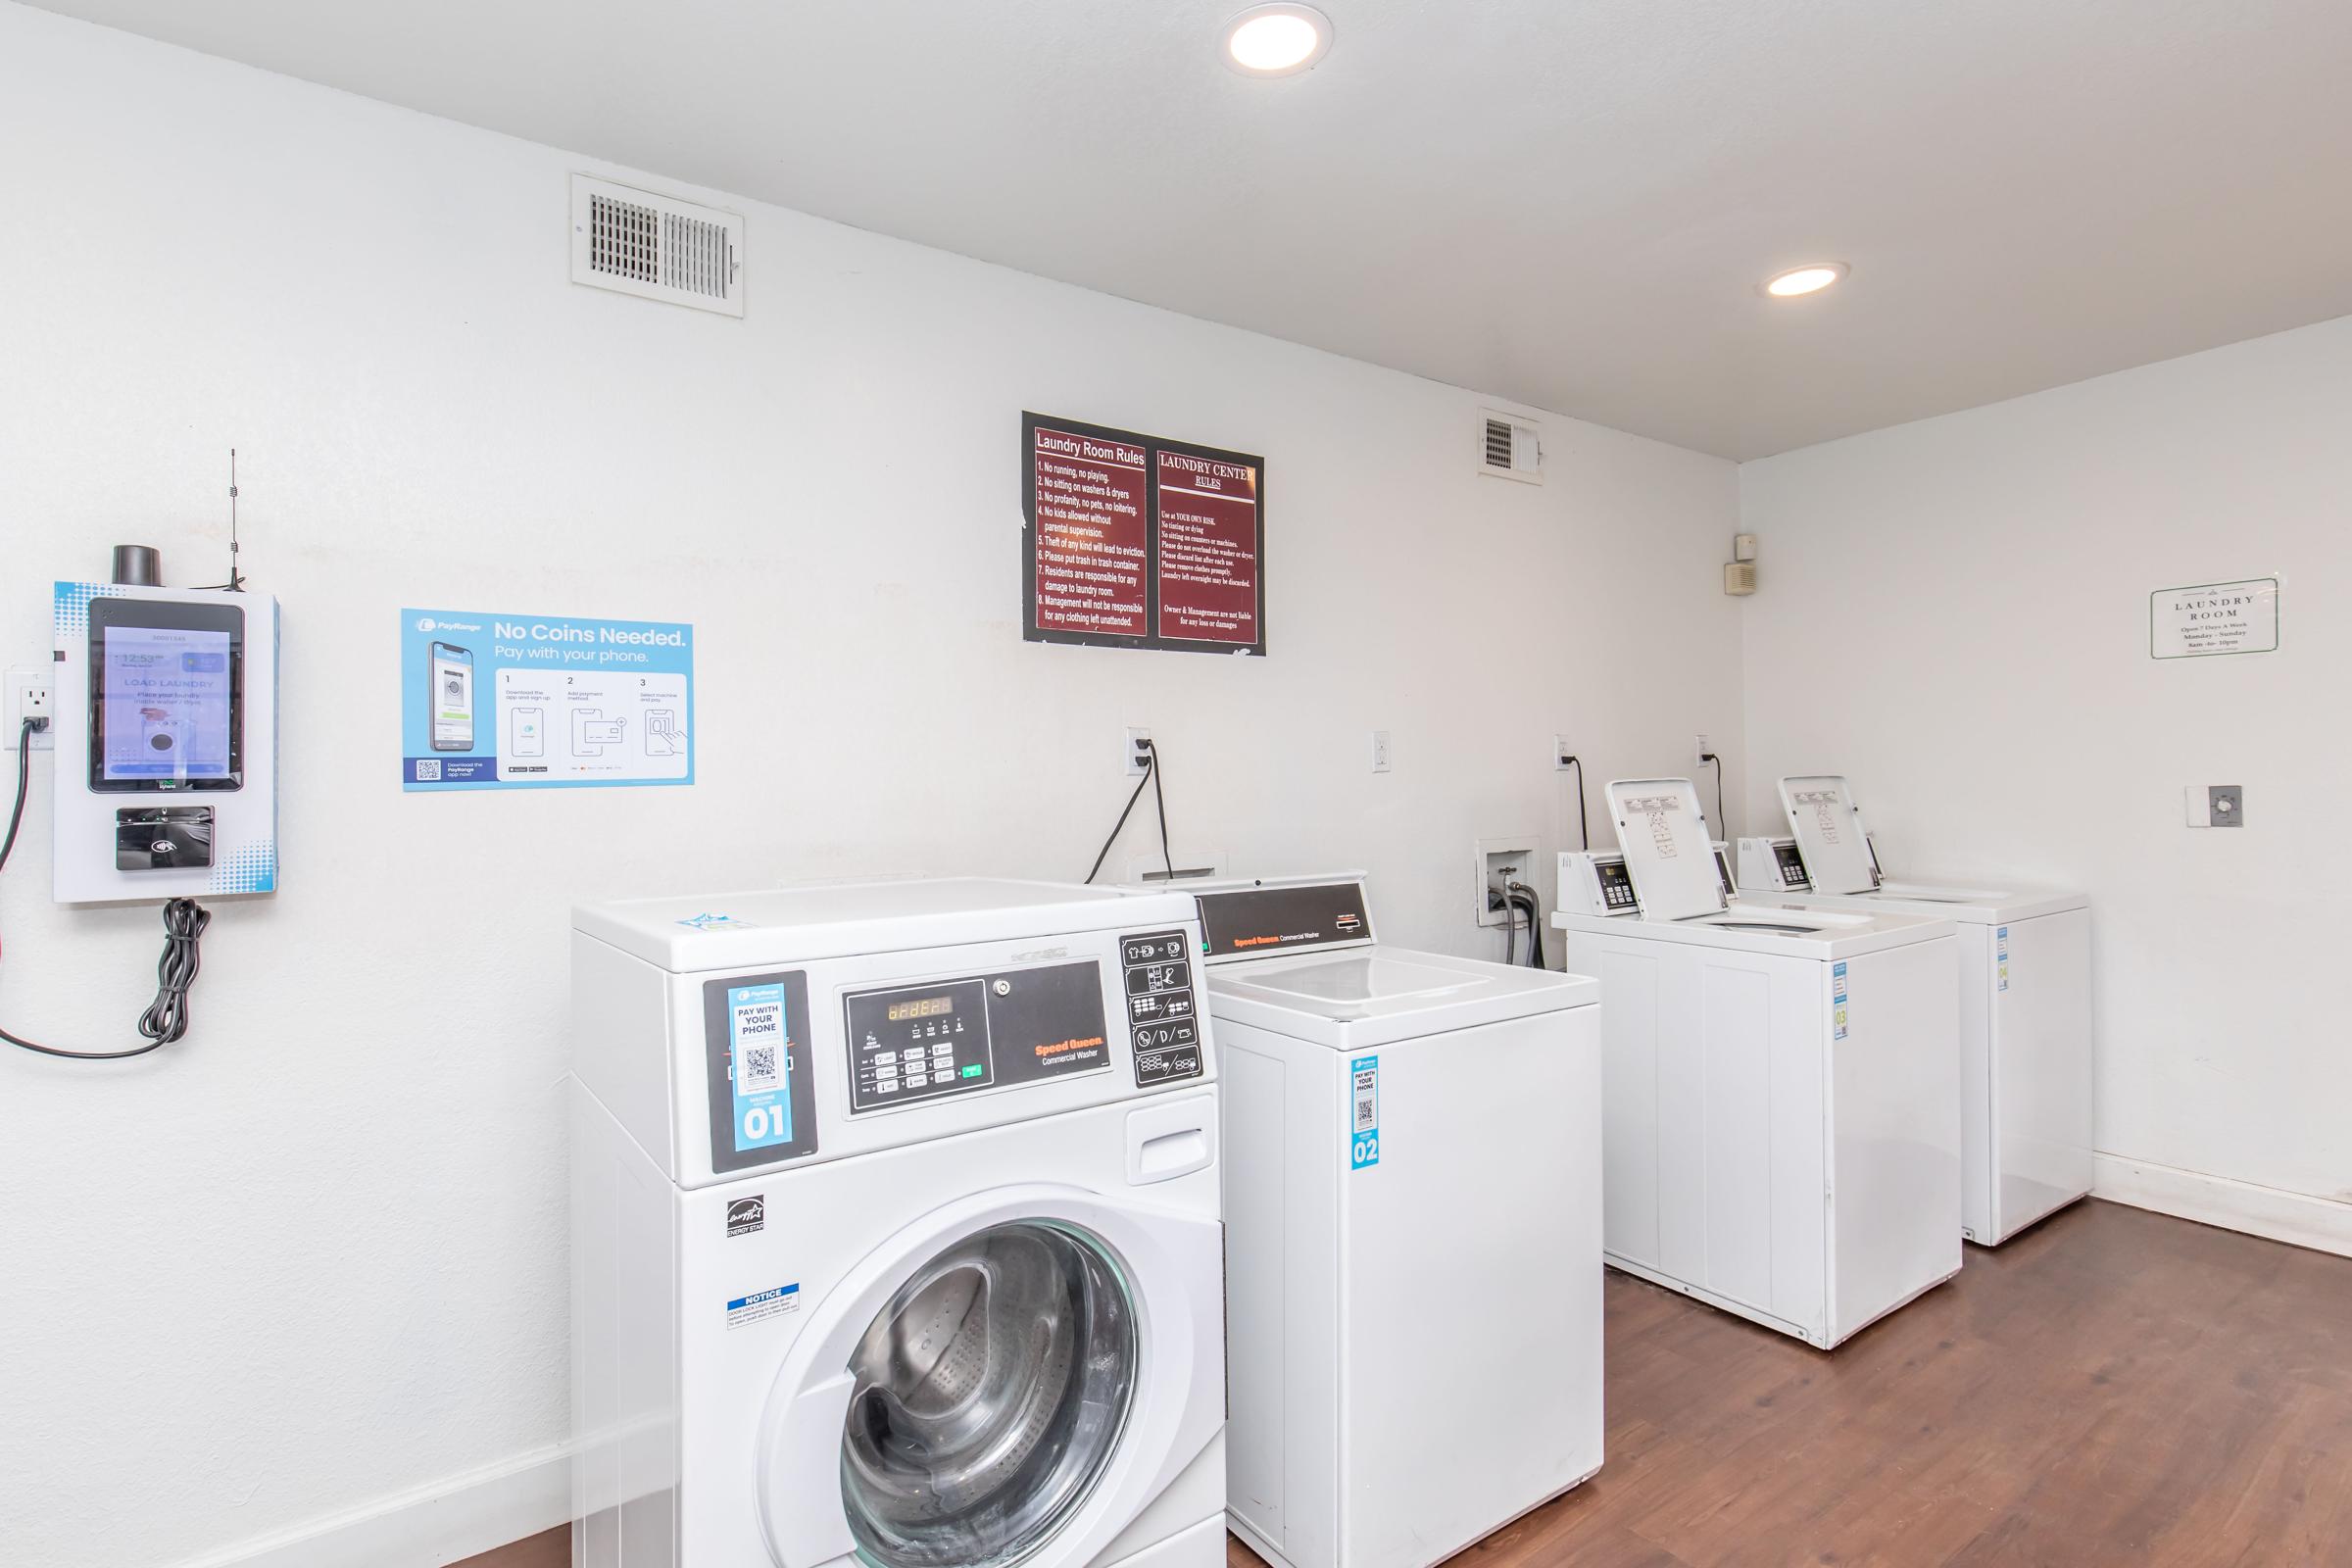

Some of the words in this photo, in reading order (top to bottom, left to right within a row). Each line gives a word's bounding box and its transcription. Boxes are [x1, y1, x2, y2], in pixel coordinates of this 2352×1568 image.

[1037, 433, 1080, 457] Laundry
[1084, 441, 1113, 460] Room
[1117, 448, 1144, 465] Rules
[1038, 461, 1043, 470] 1.
[1045, 463, 1053, 472] No
[1054, 466, 1077, 478] running,
[1088, 470, 1108, 484] playing.
[1160, 454, 1210, 474] LAUNDRY
[1213, 464, 1253, 481] CENTER
[1038, 475, 1043, 485] 2.
[1045, 476, 1053, 486] No
[1054, 479, 1072, 492] sitting
[1082, 484, 1104, 495] washers
[1106, 487, 1109, 496] &
[1111, 488, 1129, 500] dryers
[1196, 476, 1220, 488] RULES
[1039, 490, 1043, 500] 3.
[1045, 492, 1053, 502] No
[1054, 494, 1080, 508] profanity,
[1091, 500, 1103, 511] pets,
[1113, 502, 1137, 516] loitering.
[1039, 506, 1043, 514] 4.
[1045, 506, 1053, 515] No
[1054, 508, 1066, 517] kids
[1068, 510, 1089, 521] allowed
[1091, 514, 1111, 524] without
[1045, 523, 1068, 533] parental
[1069, 526, 1103, 537] supervision.
[1191, 525, 1203, 534] dying
[1039, 535, 1043, 545] 5.
[1045, 536, 1059, 547] Theft
[1061, 538, 1066, 547] of
[1068, 541, 1078, 551] any
[1080, 540, 1092, 551] kind
[1094, 543, 1102, 552] will
[1103, 544, 1114, 554] lead
[1116, 546, 1121, 555] to
[1123, 547, 1145, 557] eviction.
[1039, 551, 1043, 560] 6.
[1045, 551, 1063, 562] Please
[1065, 555, 1074, 564] put
[1076, 555, 1090, 564] trash
[1092, 557, 1097, 565] in
[1098, 558, 1111, 566] trash
[1113, 561, 1139, 570] container.
[1039, 564, 1043, 574] 7.
[1045, 565, 1073, 577] Residents
[1085, 572, 1116, 582] responsible
[1127, 576, 1136, 586] any
[1045, 580, 1067, 594] damage
[1076, 584, 1097, 596] laundry
[1039, 594, 1043, 604] 8.
[1045, 595, 1081, 608] Management
[1082, 599, 1092, 608] will
[1103, 601, 1110, 610] be
[1111, 604, 1143, 613] responsible
[1164, 605, 1181, 613] Owner
[1188, 607, 1219, 616] Management
[2175, 595, 2253, 610] LAUNDRY
[1054, 613, 1064, 622] any
[1066, 612, 1089, 624] clothing
[1101, 616, 1132, 626] unattended.
[2189, 609, 2236, 620] ROOM
[438, 621, 480, 632] PayRange
[1216, 620, 1237, 629] damages
[494, 622, 525, 640] No
[531, 623, 594, 643] Coins
[600, 627, 685, 647] Needed.
[495, 645, 519, 660] Pay
[526, 646, 559, 659] with
[563, 650, 594, 662] your
[600, 649, 648, 664] phone.
[1234, 937, 1257, 947] Speed
[738, 1006, 755, 1017] PAY
[757, 1004, 778, 1014] WITH
[1836, 1010, 1846, 1025] 03
[746, 1014, 773, 1024] YOUR
[742, 1023, 776, 1035] PHONE
[1035, 1041, 1069, 1056] Speed
[1070, 1036, 1103, 1050] Queen
[1042, 1052, 1079, 1066] Commercial
[1080, 1049, 1099, 1060] Washer
[744, 1104, 784, 1140] 01
[1354, 1139, 1377, 1163] 02
[728, 1227, 749, 1237] ENERGY
[746, 1289, 781, 1304] NOTICE
